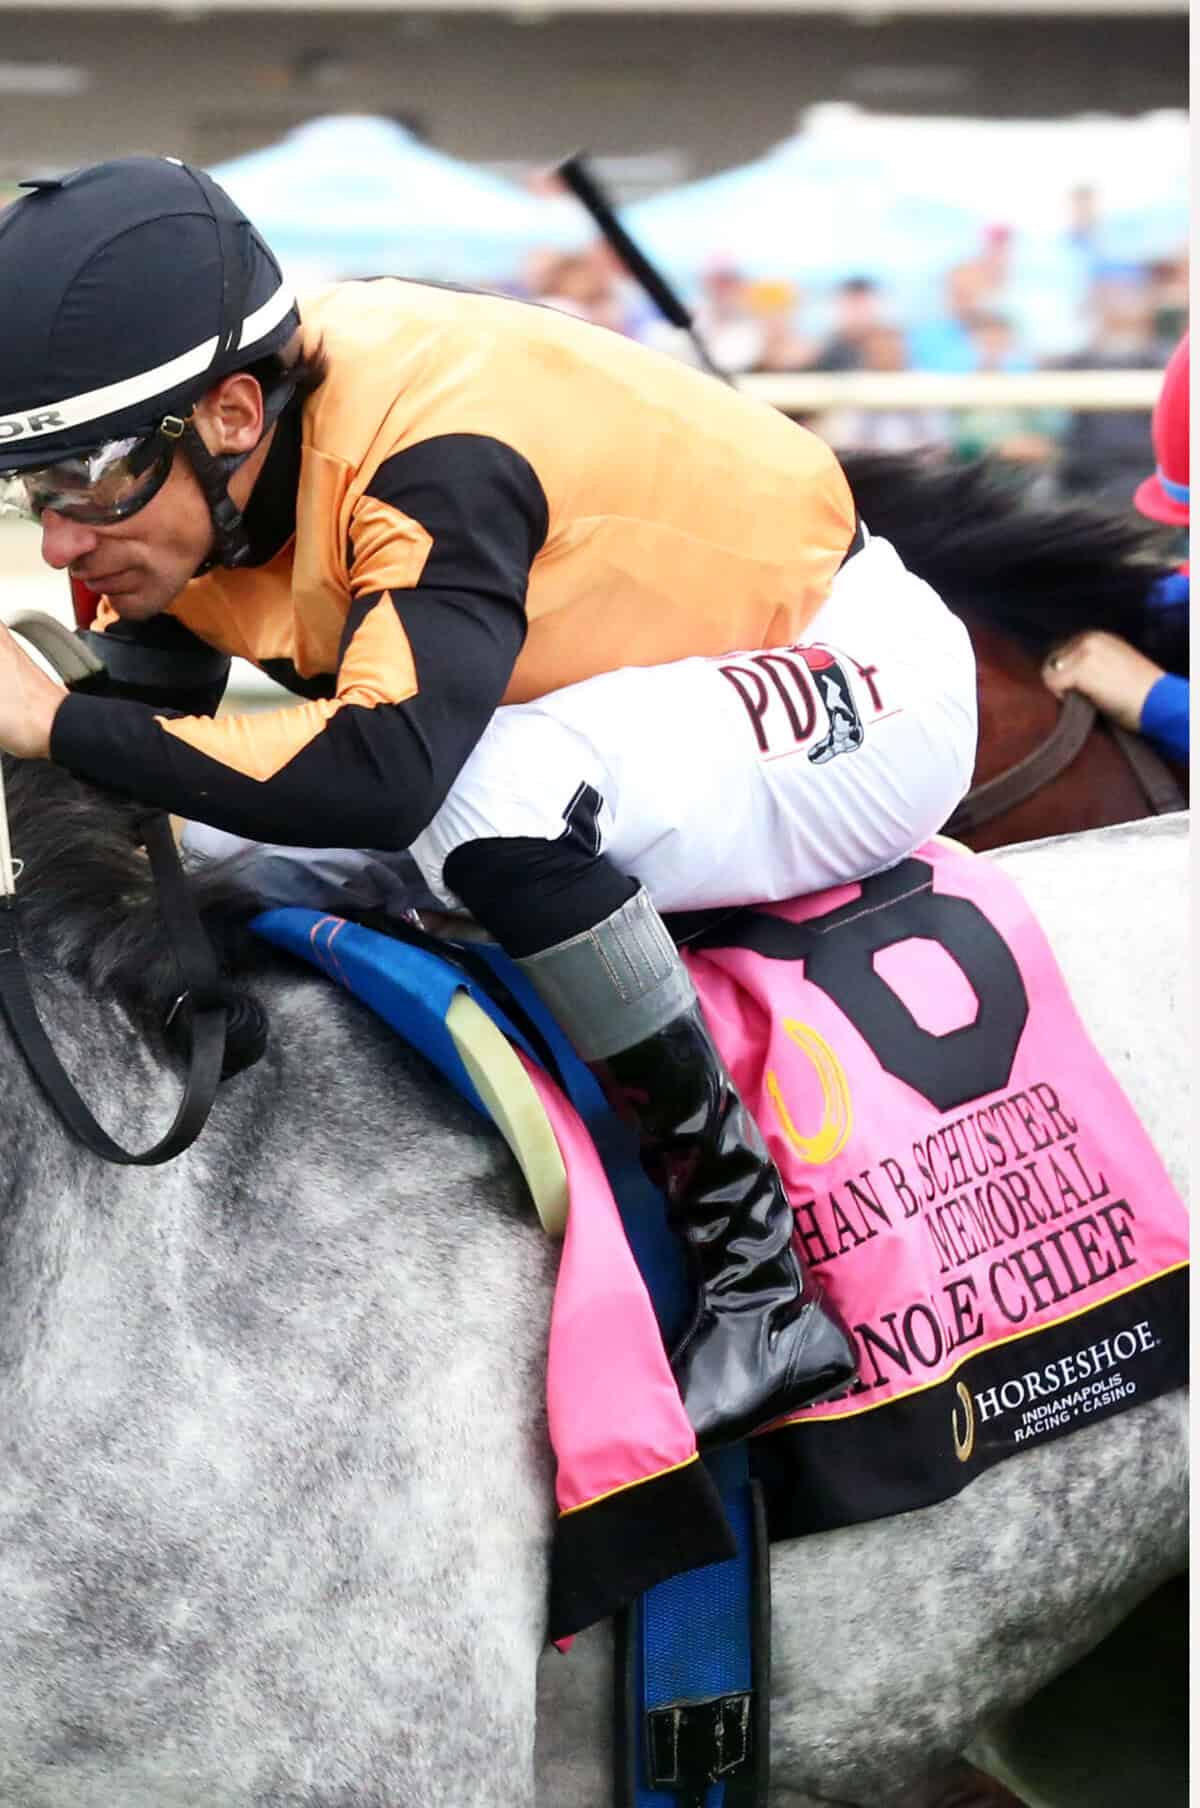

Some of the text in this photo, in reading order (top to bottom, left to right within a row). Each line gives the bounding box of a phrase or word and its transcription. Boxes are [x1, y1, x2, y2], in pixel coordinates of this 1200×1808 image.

[793, 1170, 894, 1268] HAN
[912, 1082, 1078, 1201] SCHUSTER
[924, 1143, 1110, 1274] MEMORIAL
[989, 1199, 1137, 1324] CHIEF
[975, 1321, 1155, 1422] HORSESHOE
[1014, 1381, 1137, 1442] RACING CASINO
[1021, 1373, 1123, 1425] INDIANAPOLIS
